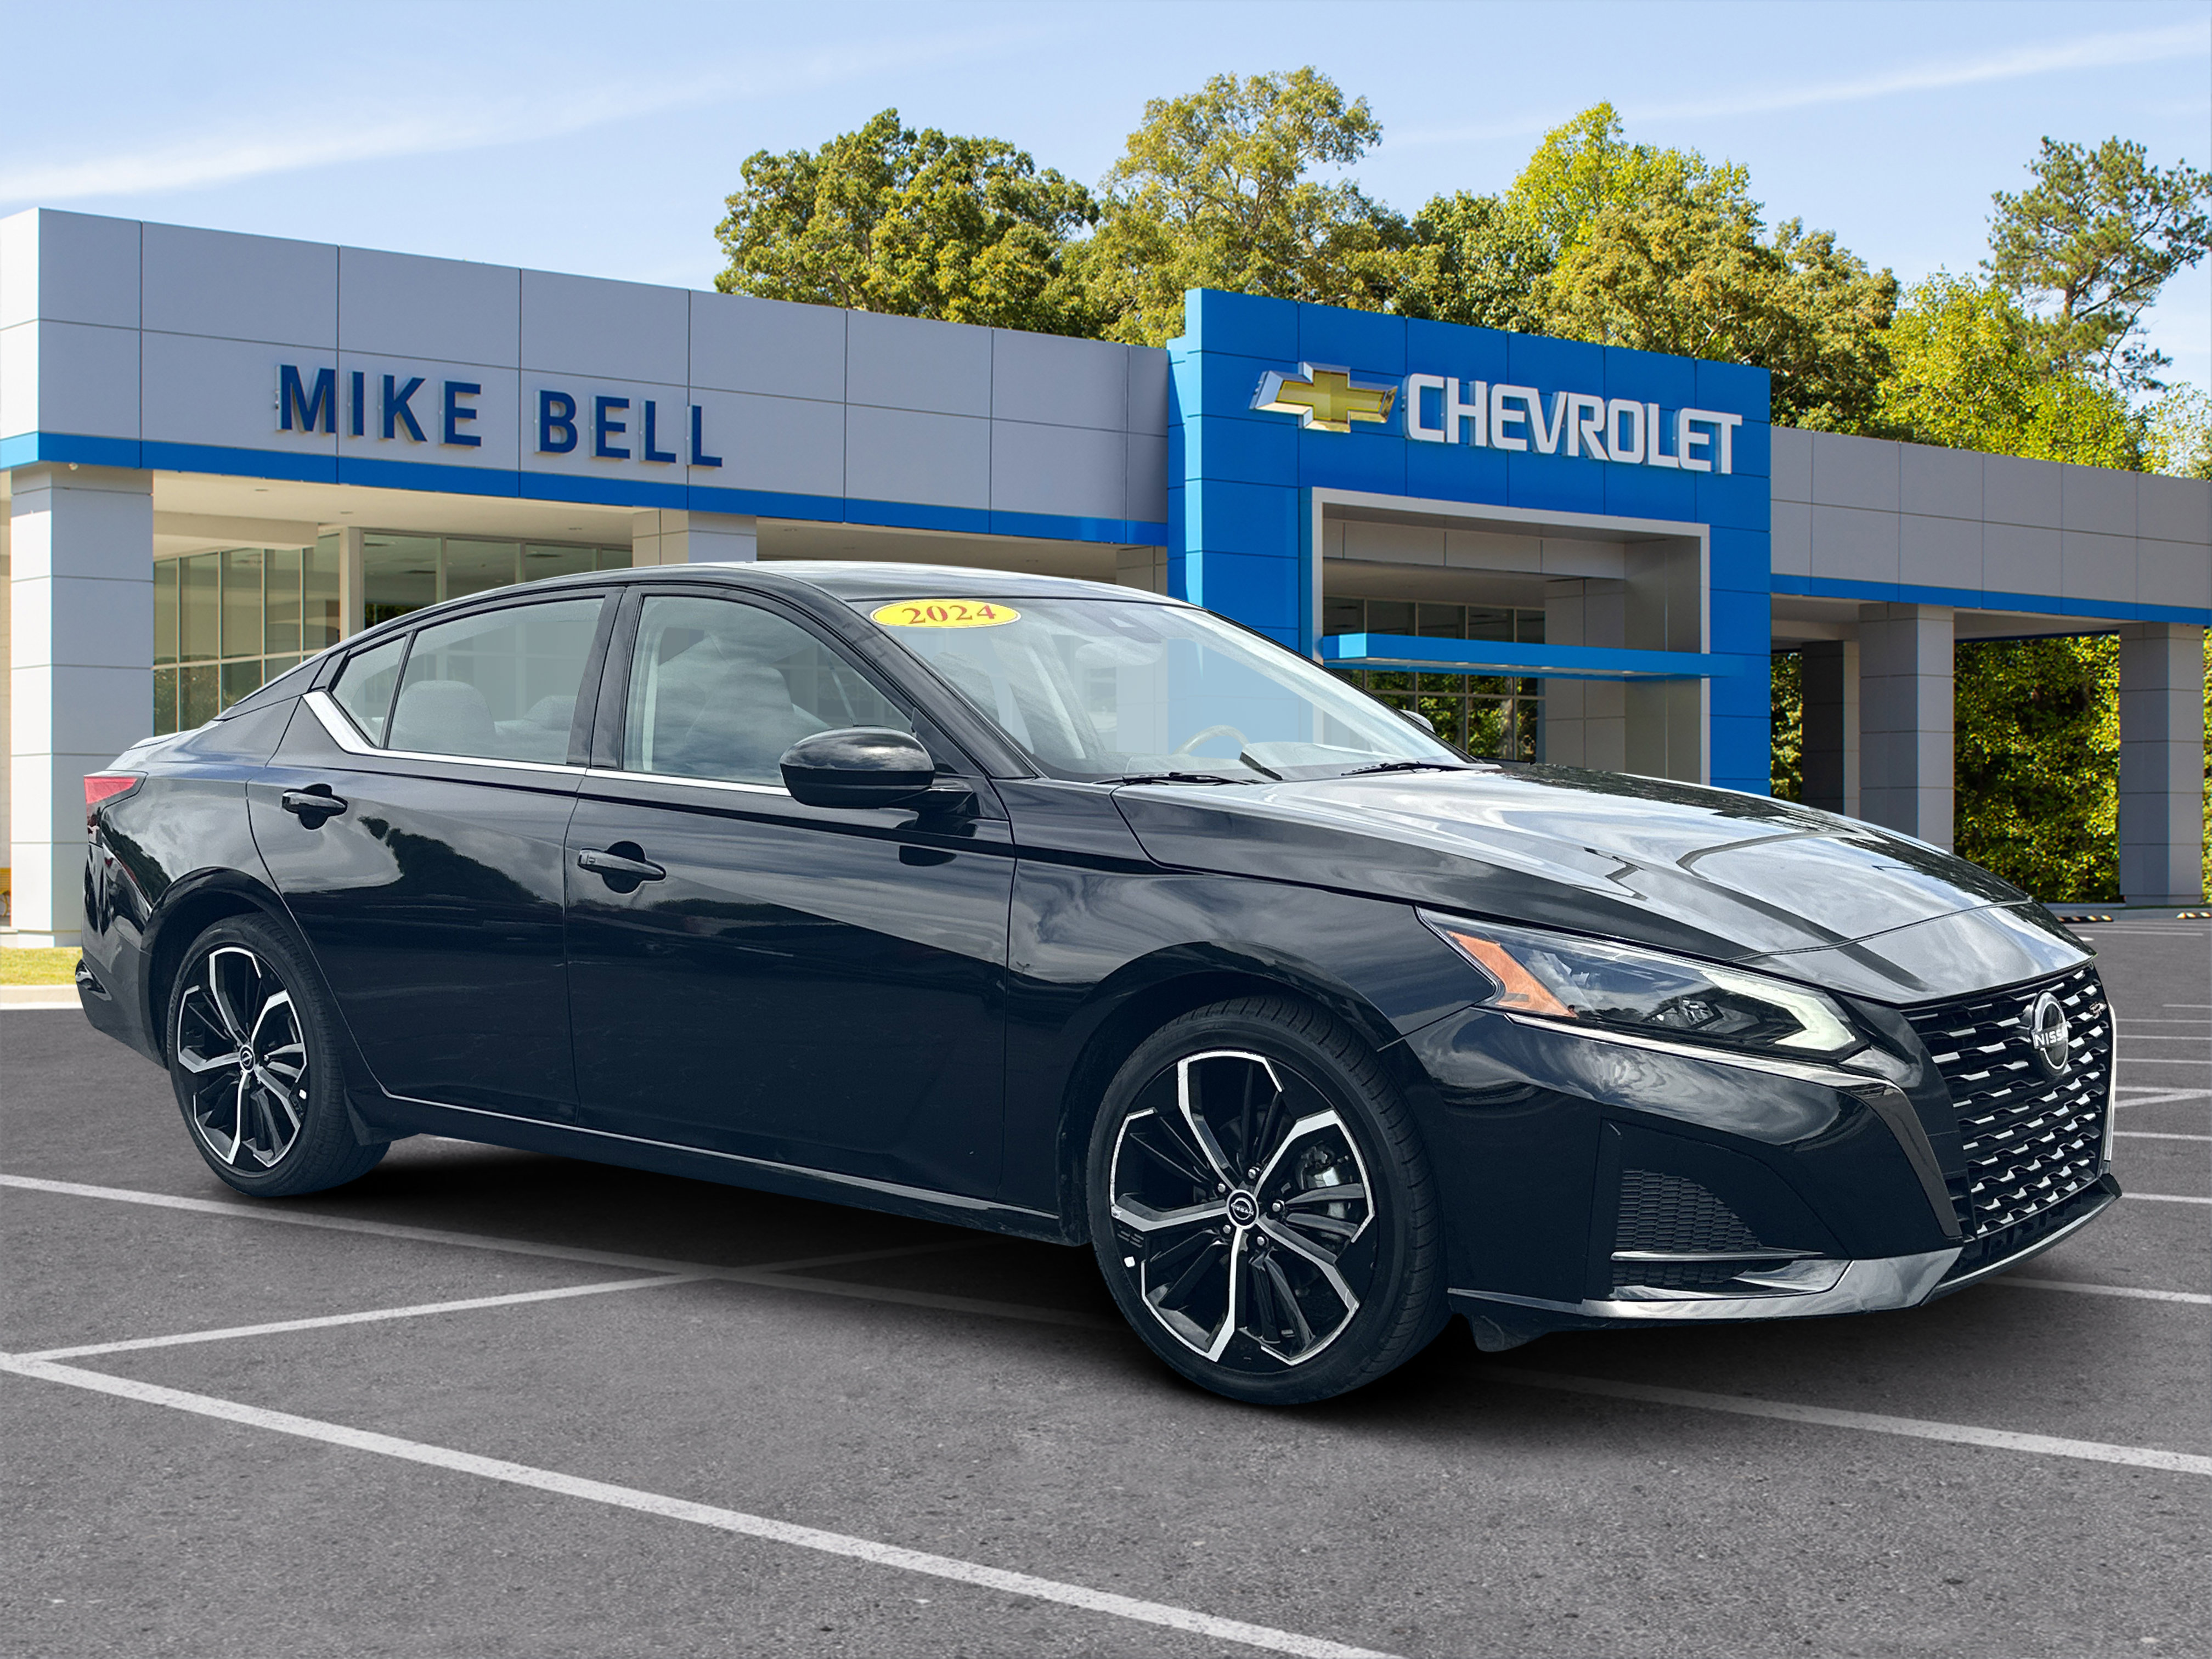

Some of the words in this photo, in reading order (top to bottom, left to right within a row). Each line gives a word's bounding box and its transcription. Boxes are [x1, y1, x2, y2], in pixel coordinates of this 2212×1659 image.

[276, 364, 482, 447] MIKE
[534, 390, 723, 468] BELL
[1403, 373, 1742, 475] CHEVROLET
[901, 605, 996, 624] 2024
[2034, 1025, 2068, 1047] NISS
